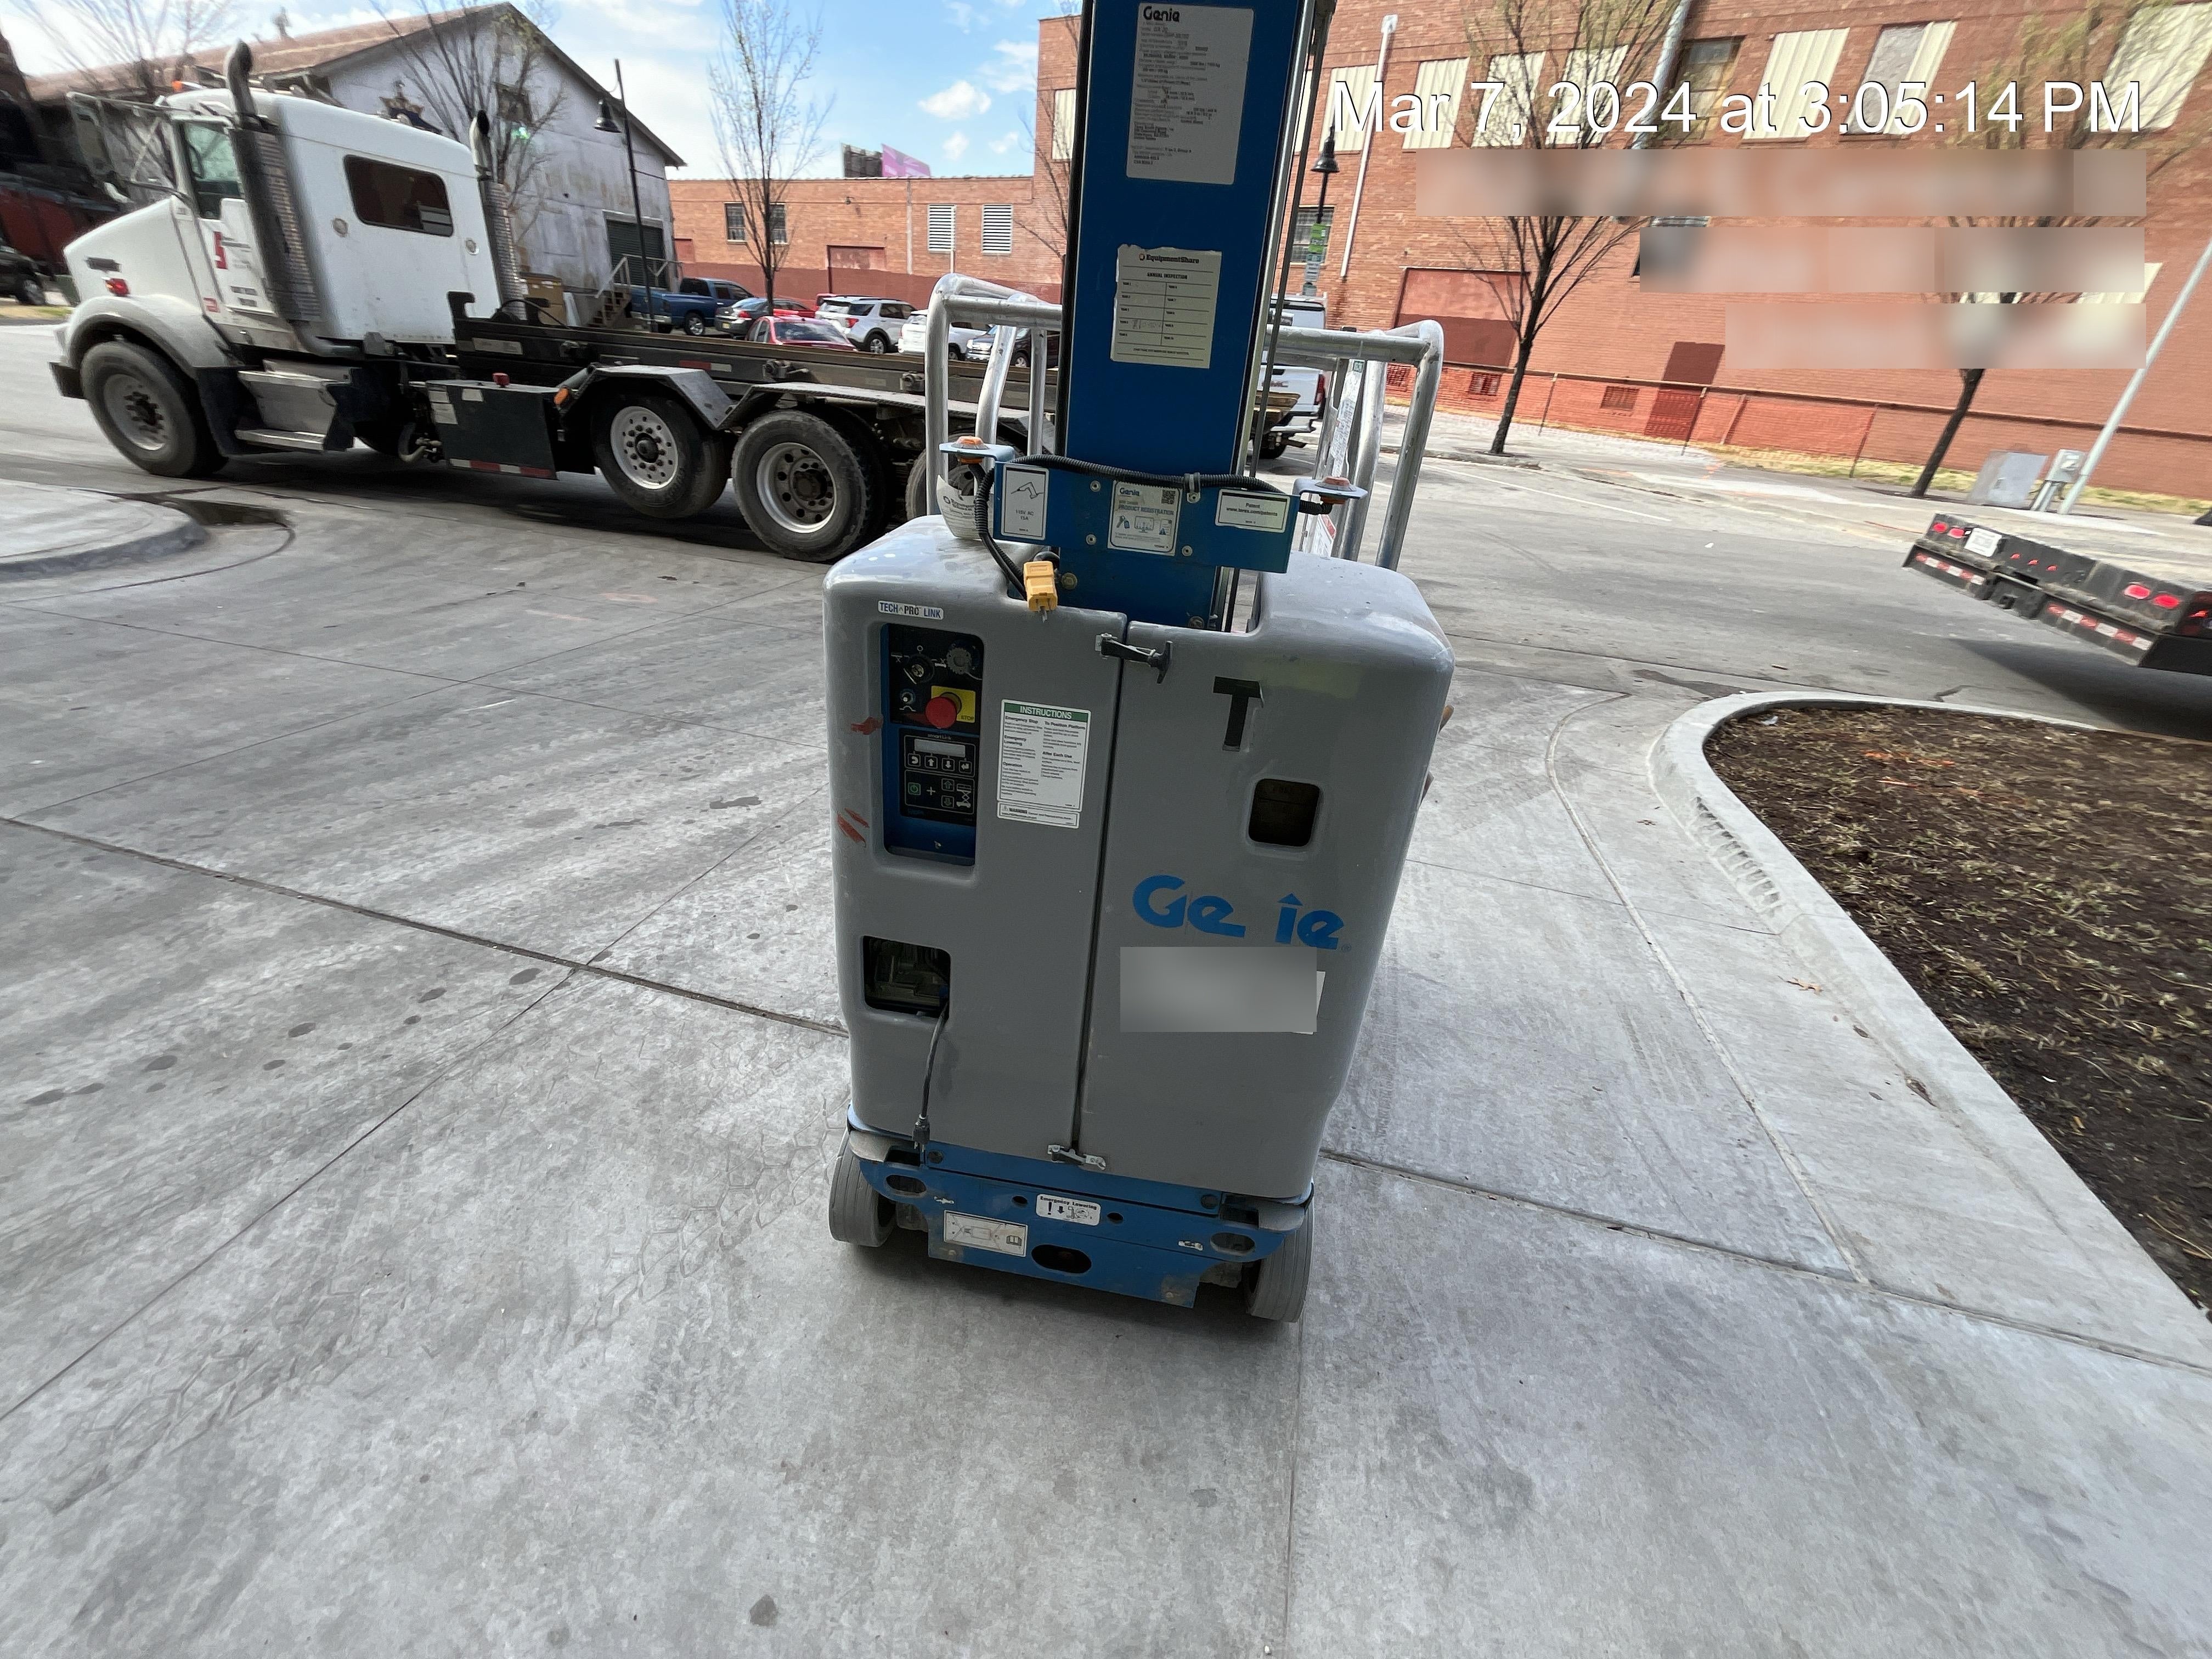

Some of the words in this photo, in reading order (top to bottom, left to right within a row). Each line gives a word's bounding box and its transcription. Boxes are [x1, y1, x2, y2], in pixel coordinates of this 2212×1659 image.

[1143, 6, 1180, 21] Genie
[1146, 254, 1199, 263] EquipmentShare
[1119, 487, 1139, 496] Genie
[879, 602, 898, 613] TECH
[923, 608, 941, 618] LINK
[1019, 706, 1072, 719] INSTRUCTIONS
[1213, 676, 1264, 752] T
[1132, 874, 1344, 950] Geie
[1040, 1195, 1070, 1205] Emergency
[1072, 1201, 1097, 1210] Lowering
